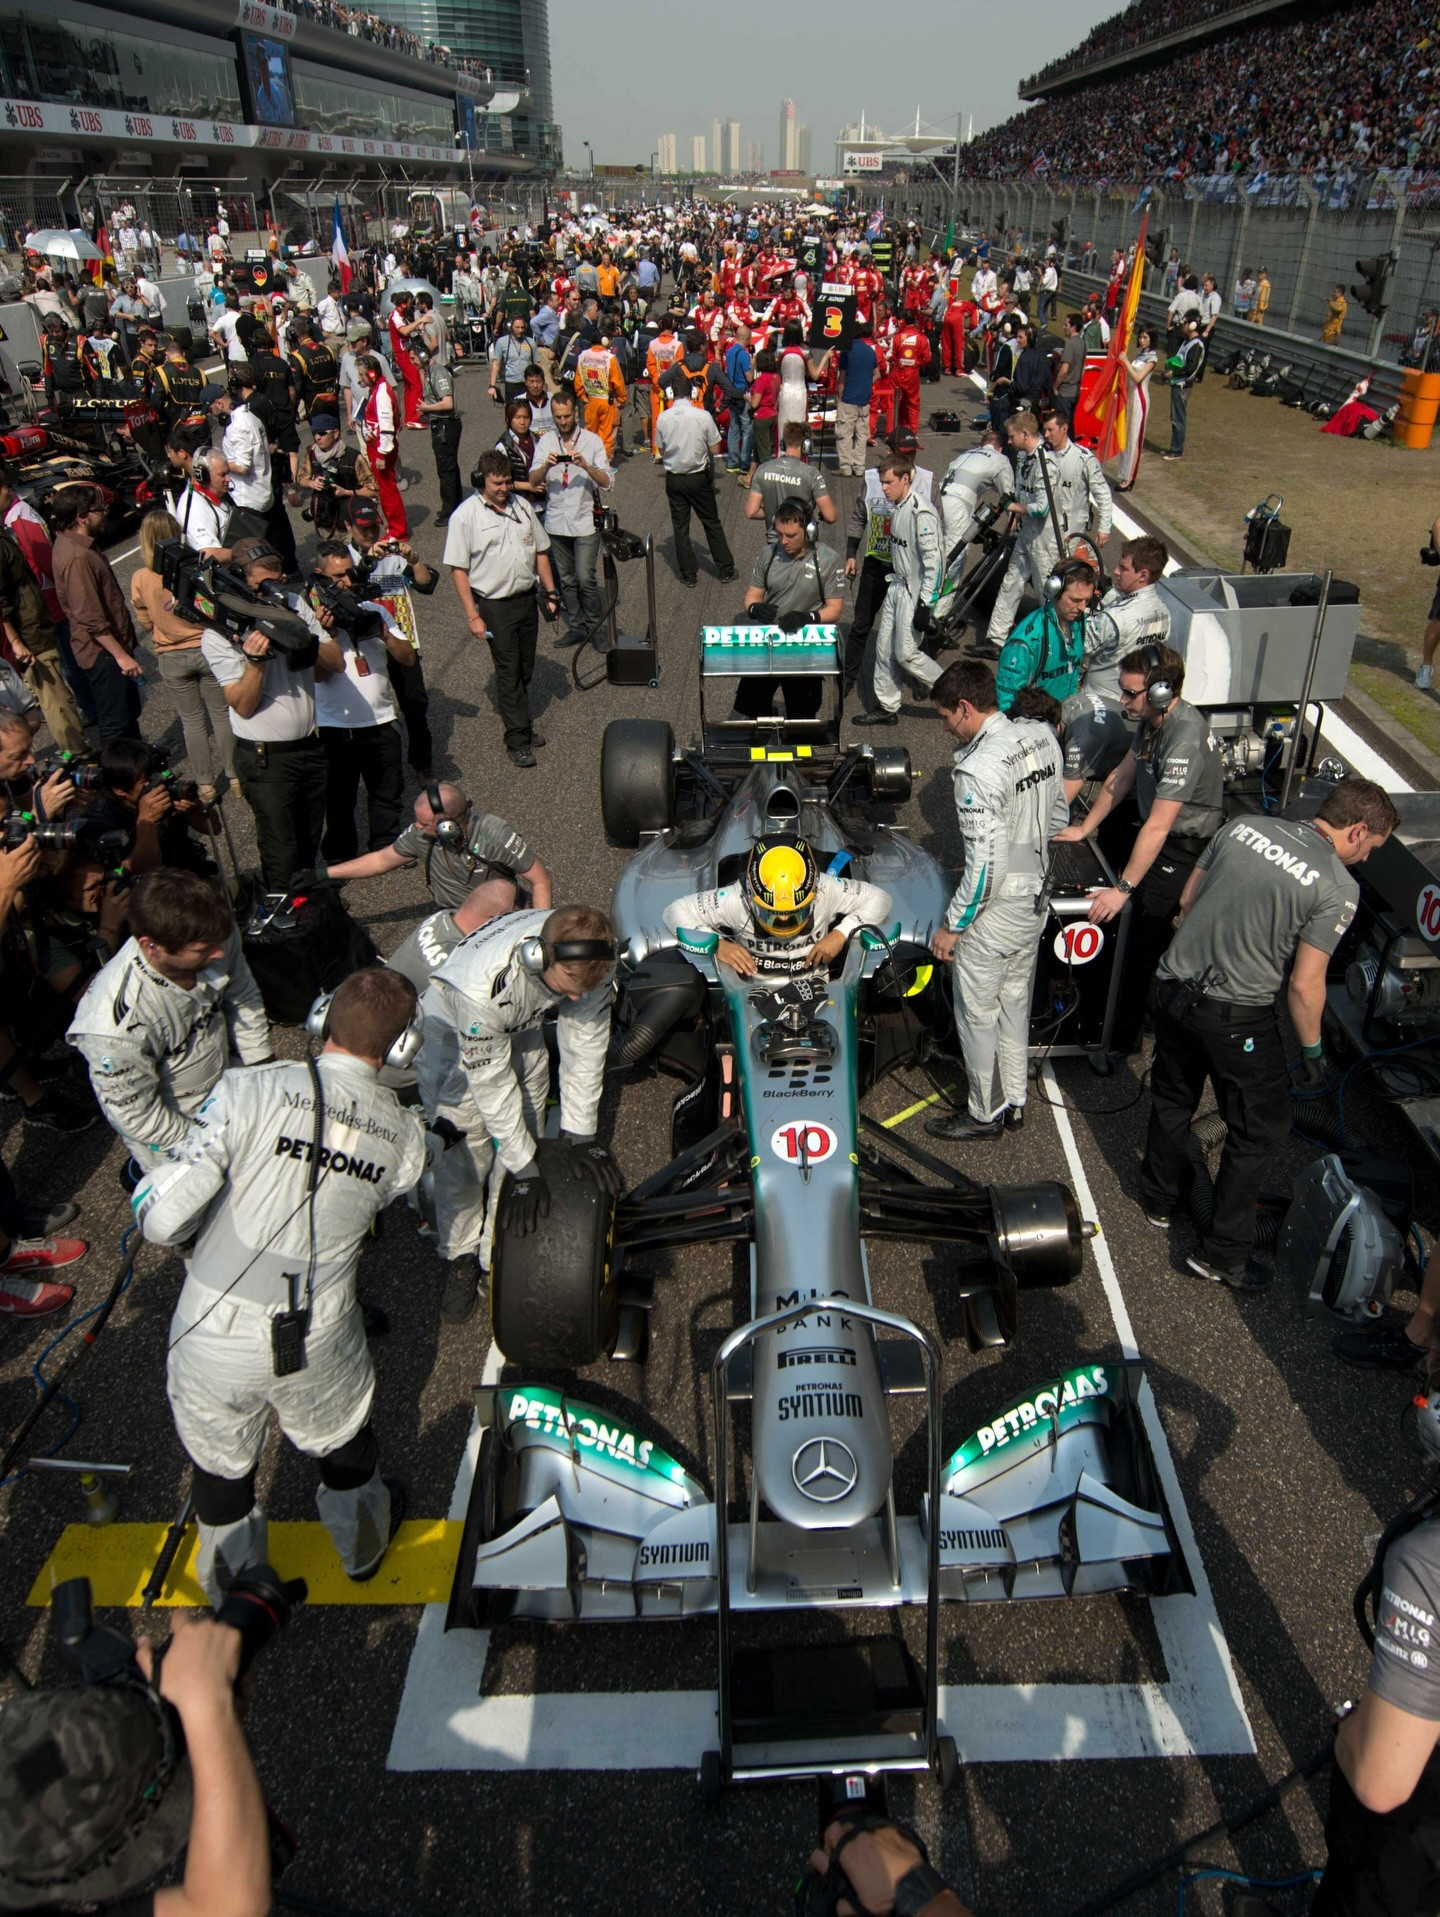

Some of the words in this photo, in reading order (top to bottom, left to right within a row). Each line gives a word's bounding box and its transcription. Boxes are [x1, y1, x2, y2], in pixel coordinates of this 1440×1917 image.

[250, 6, 266, 26] UBS
[278, 15, 294, 35] UBS
[16, 105, 44, 128] UBS
[79, 111, 103, 132] UBS
[132, 117, 153, 137] UBS
[180, 122, 197, 140] UBS
[218, 126, 235, 143] UBS
[321, 135, 333, 150] UBS
[857, 156, 880, 167] UBS
[823, 307, 843, 338] 3
[308, 354, 331, 366] LOTUS
[171, 377, 200, 386] LOTUS
[764, 471, 802, 487] PETRONAS
[705, 628, 837, 648] PETRONAS
[1229, 823, 1320, 886] PETRONAS
[1420, 889, 1440, 937] 10
[1063, 927, 1100, 959] 10
[762, 1089, 835, 1099] BlackBerry
[779, 1126, 831, 1158] 10
[274, 1135, 386, 1185] PETRONAS
[777, 1346, 857, 1369] PIRELLI
[795, 1382, 843, 1391] PETRONAS
[778, 1392, 864, 1421] SYNTIUM
[977, 1367, 1109, 1457] PETRONAS
[508, 1394, 654, 1469] PETRONAS
[939, 1529, 1008, 1550] SYNTIUM
[640, 1541, 710, 1565] SYNTIUM
[1394, 1616, 1431, 1643] MIG
